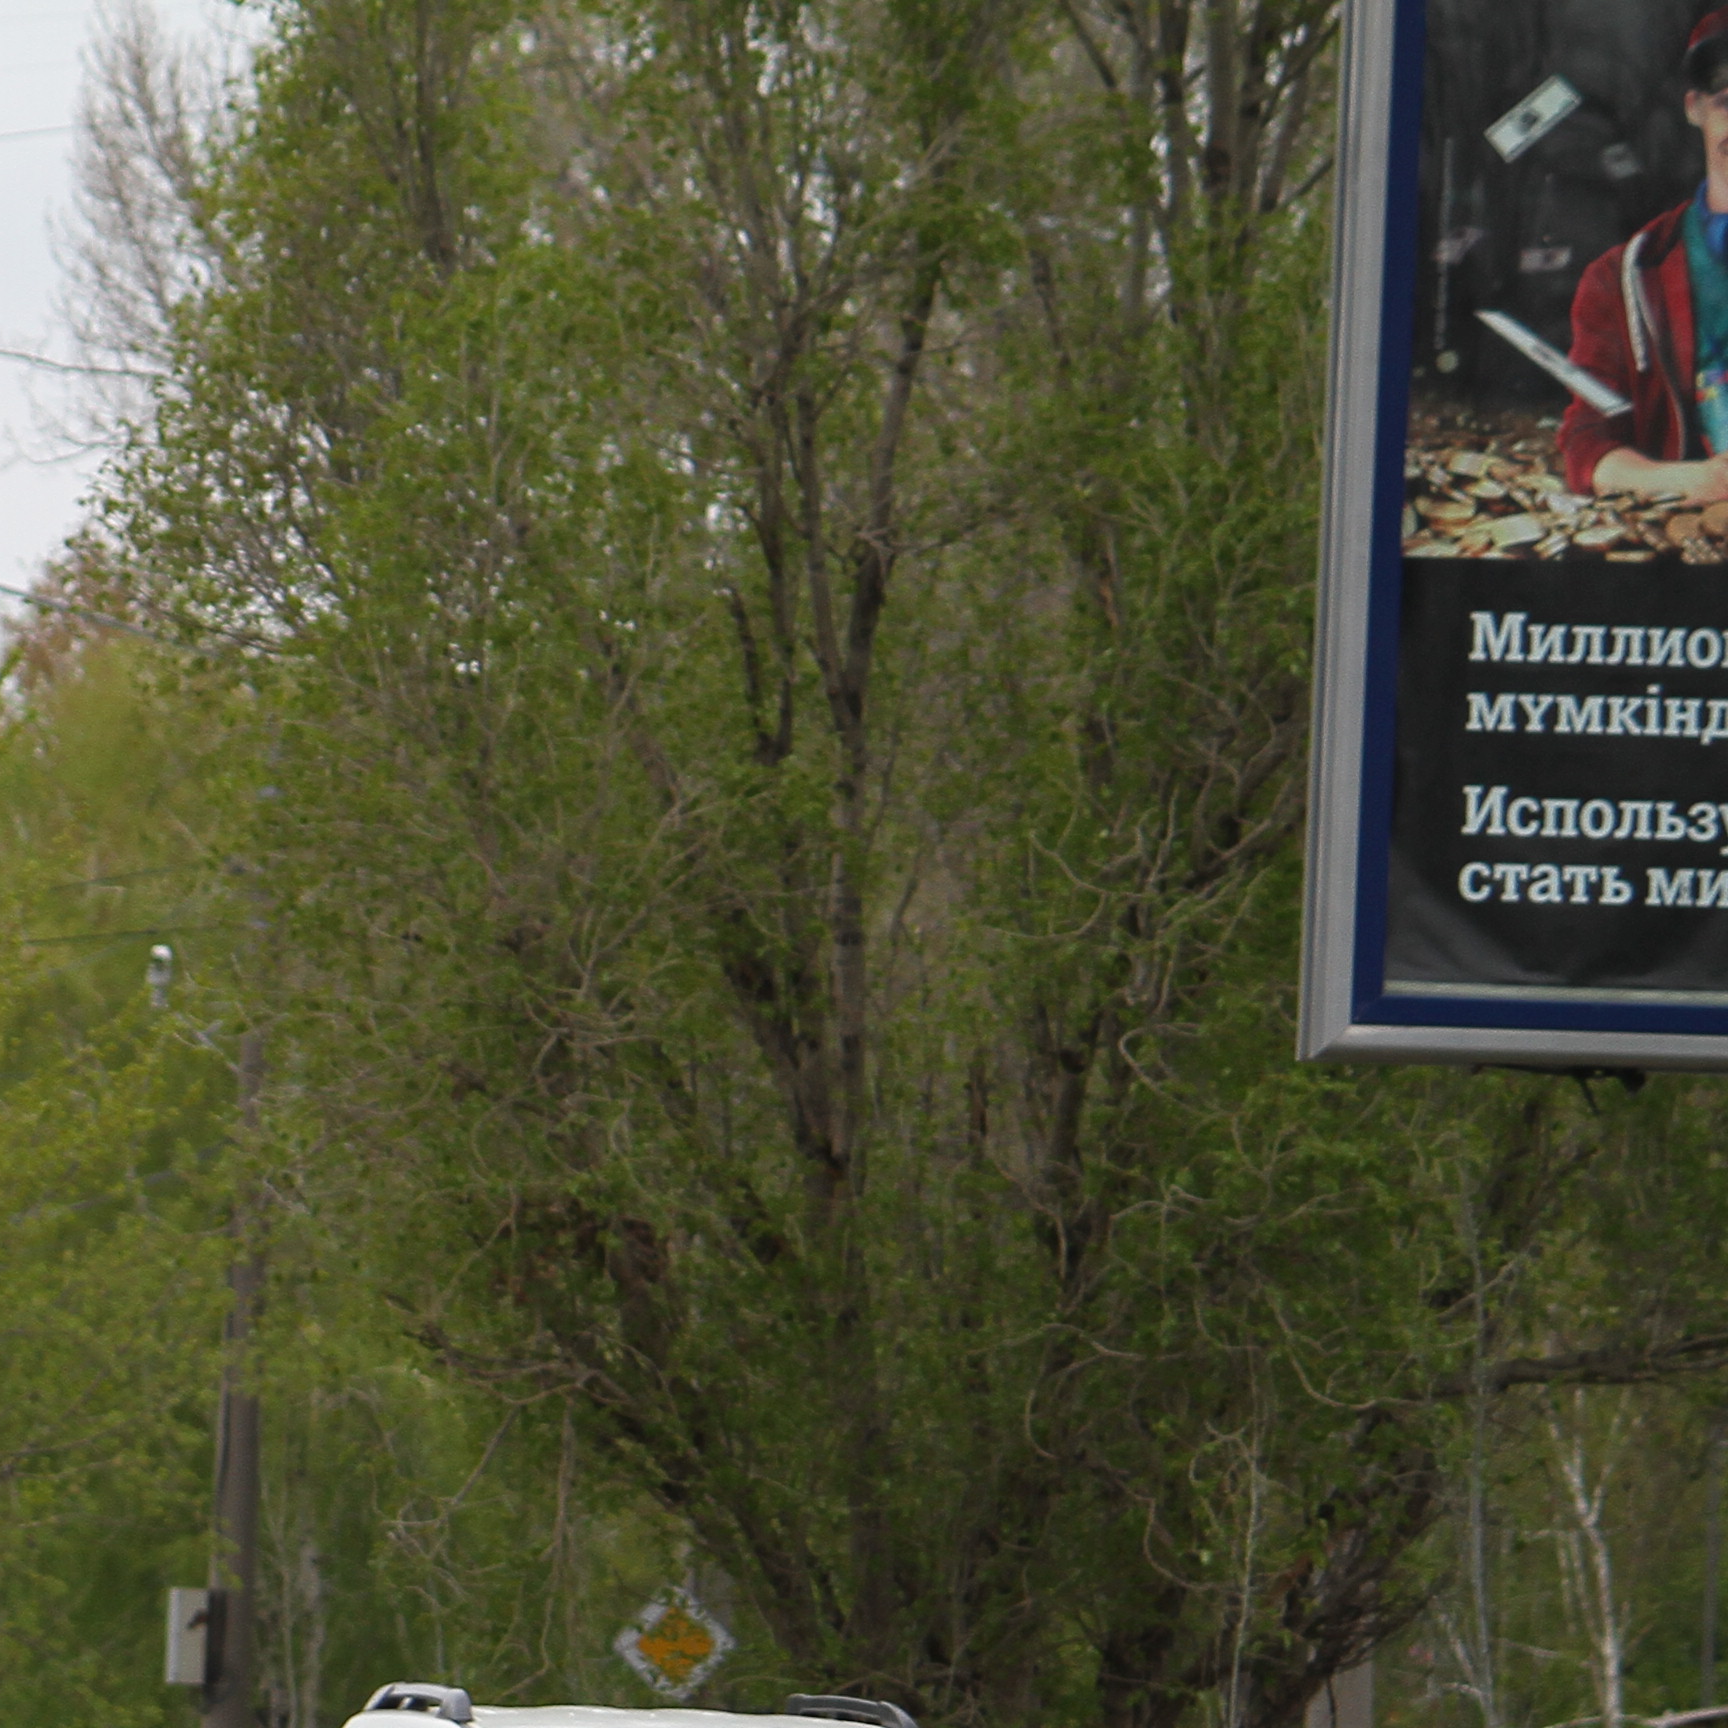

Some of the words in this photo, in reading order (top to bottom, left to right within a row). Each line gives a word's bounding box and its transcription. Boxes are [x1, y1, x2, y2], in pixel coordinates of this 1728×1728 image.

[1468, 611, 1728, 668] Миллио
[1458, 861, 1634, 905] стать
[1645, 868, 1728, 908] ми
